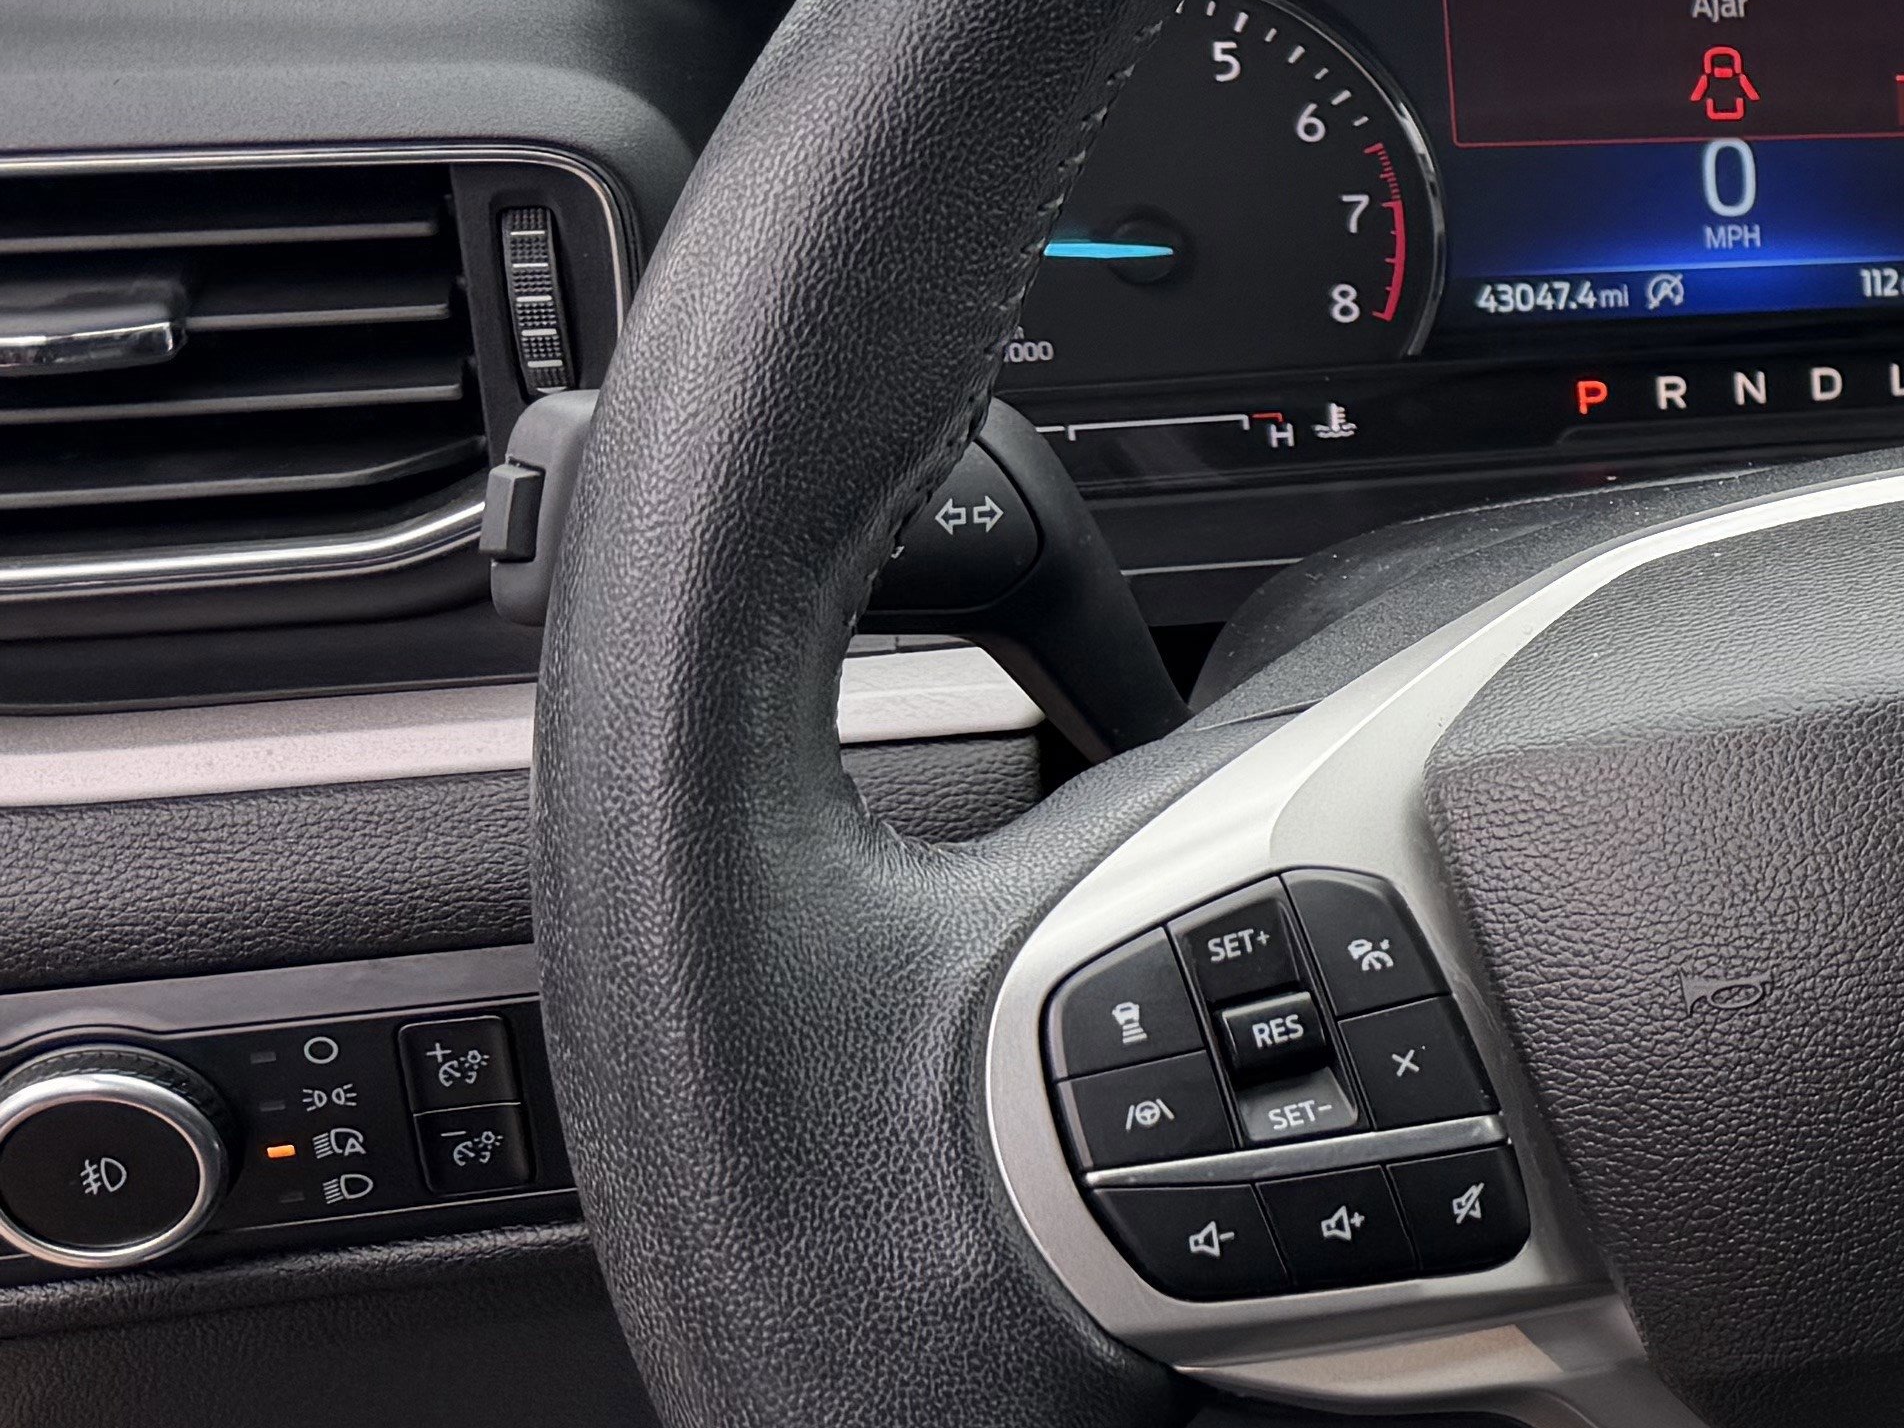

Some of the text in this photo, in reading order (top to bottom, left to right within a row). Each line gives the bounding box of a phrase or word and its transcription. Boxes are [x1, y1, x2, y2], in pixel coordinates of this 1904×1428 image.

[1212, 41, 1241, 81] 5
[1296, 105, 1327, 143] 6
[1702, 137, 1757, 220] 0
[1342, 195, 1370, 234] 7
[1704, 224, 1761, 251] MPH
[1330, 283, 1361, 322] 8
[1475, 283, 1630, 315] 43047.4 mi
[1859, 269, 1898, 298] 112
[1577, 380, 1607, 415] P
[1655, 376, 1688, 409] R
[1734, 372, 1767, 406] N
[1810, 367, 1842, 401] D
[1270, 423, 1294, 447] H
[1252, 1016, 1304, 1049] RES
